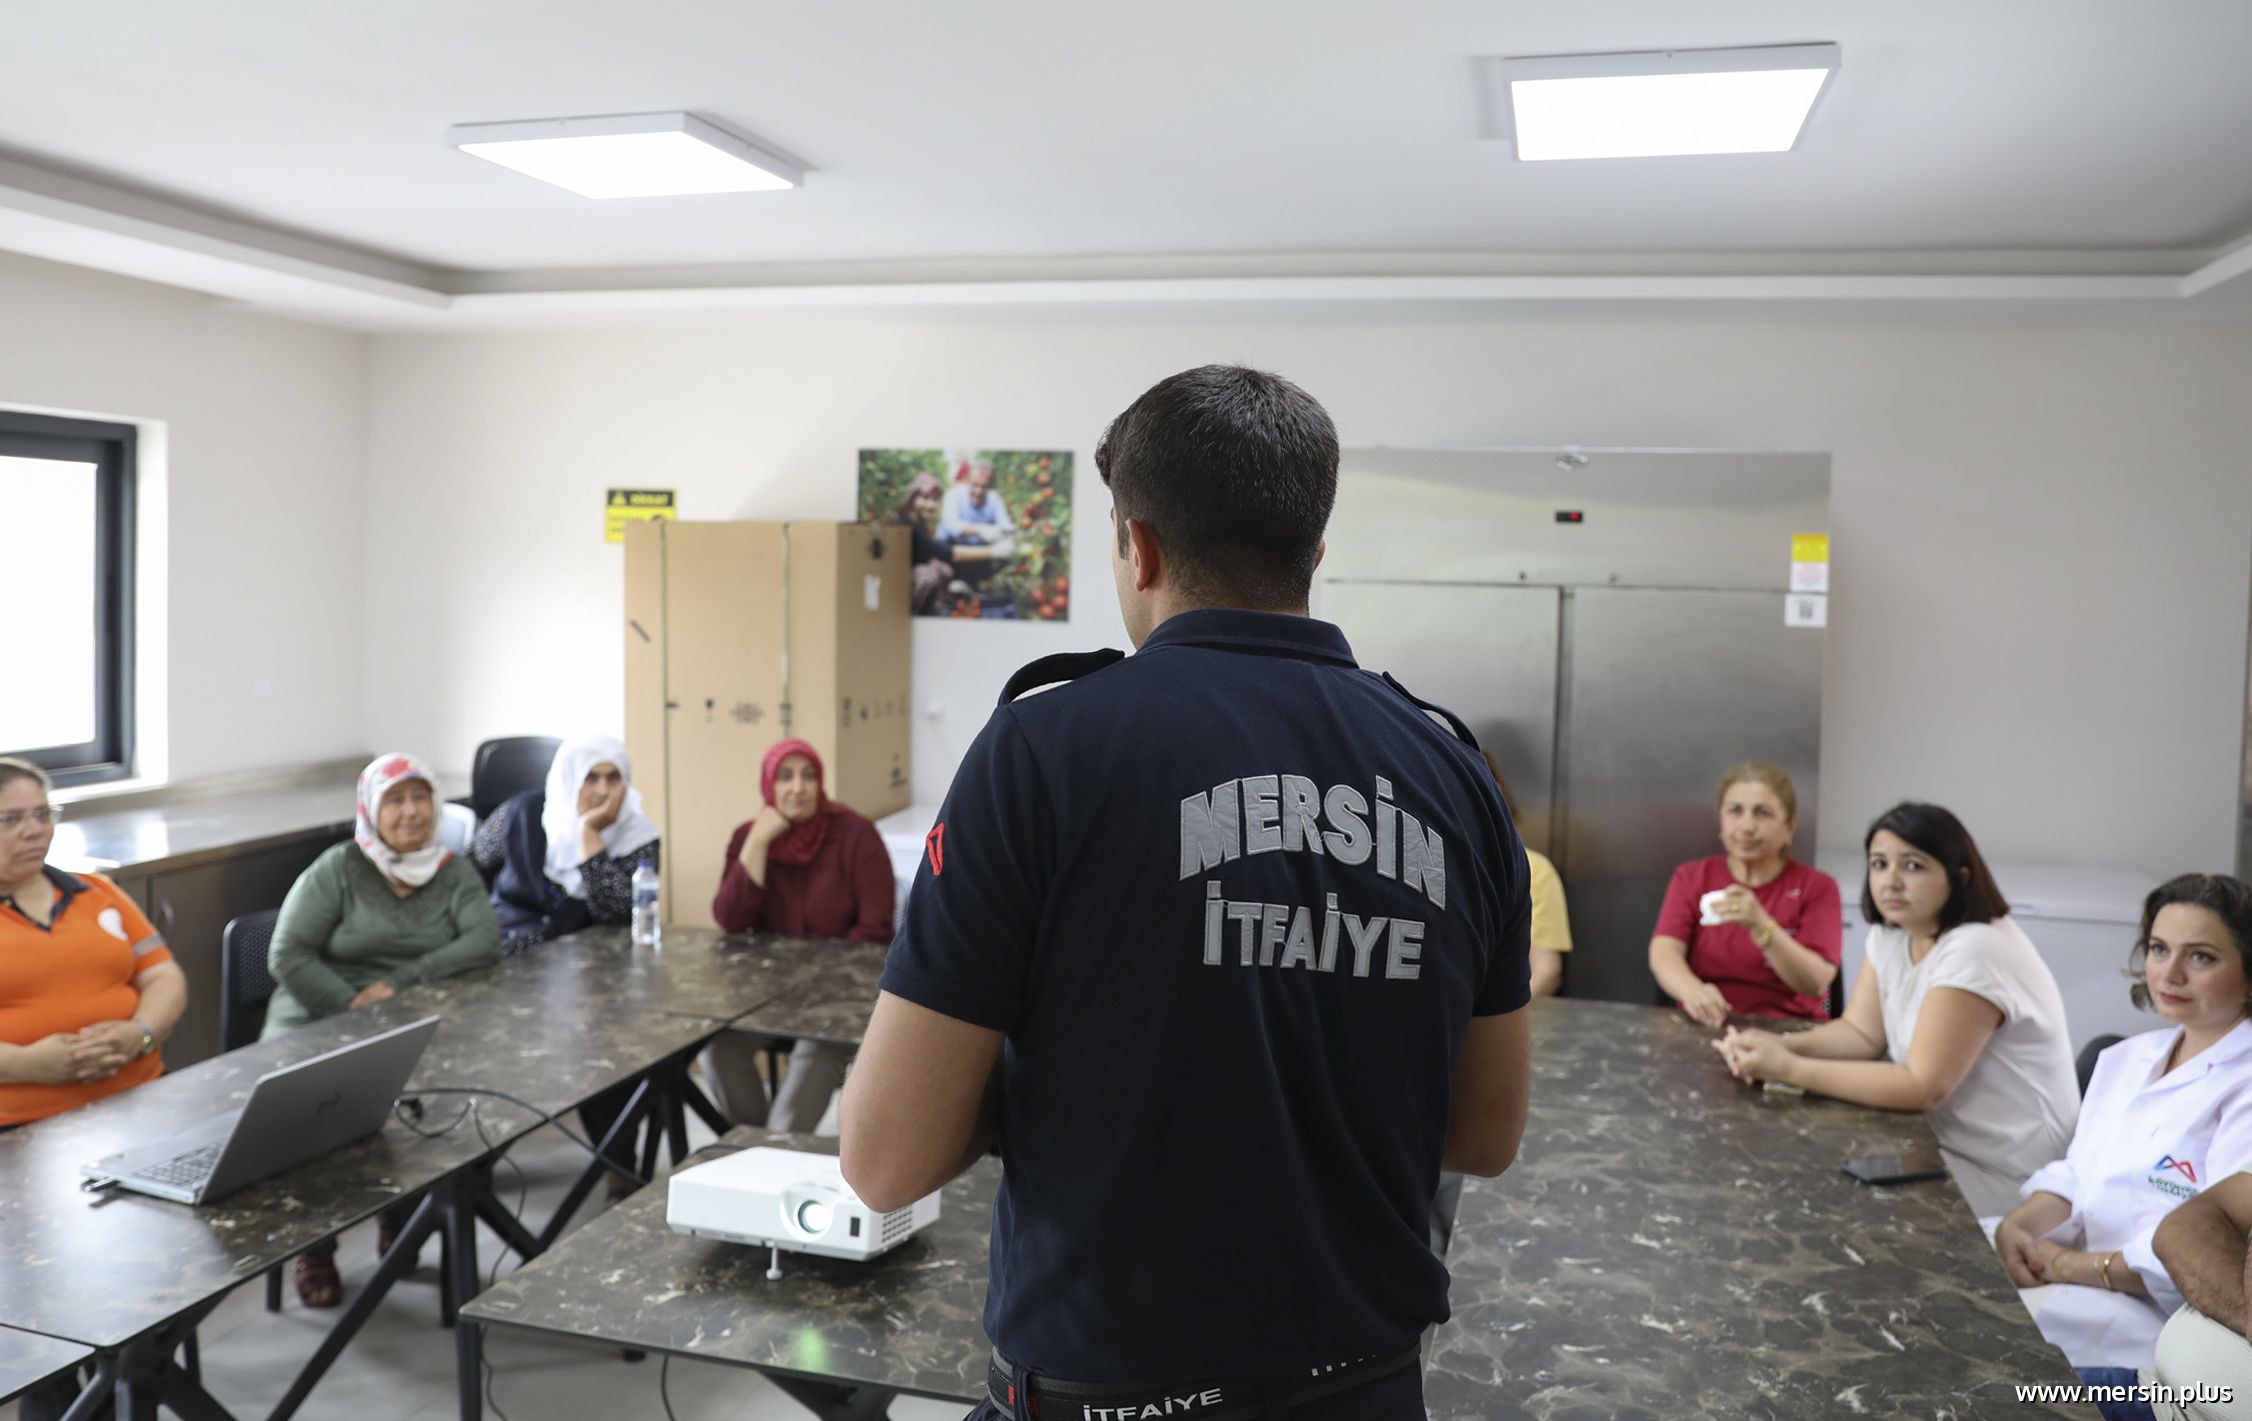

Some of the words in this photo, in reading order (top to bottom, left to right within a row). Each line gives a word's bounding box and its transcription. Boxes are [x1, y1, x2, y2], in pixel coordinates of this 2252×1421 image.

[1179, 774, 1446, 911] MERSİN
[1203, 880, 1426, 980] İTFAİYE
[1083, 1388, 1223, 1421] İTFAİYE
